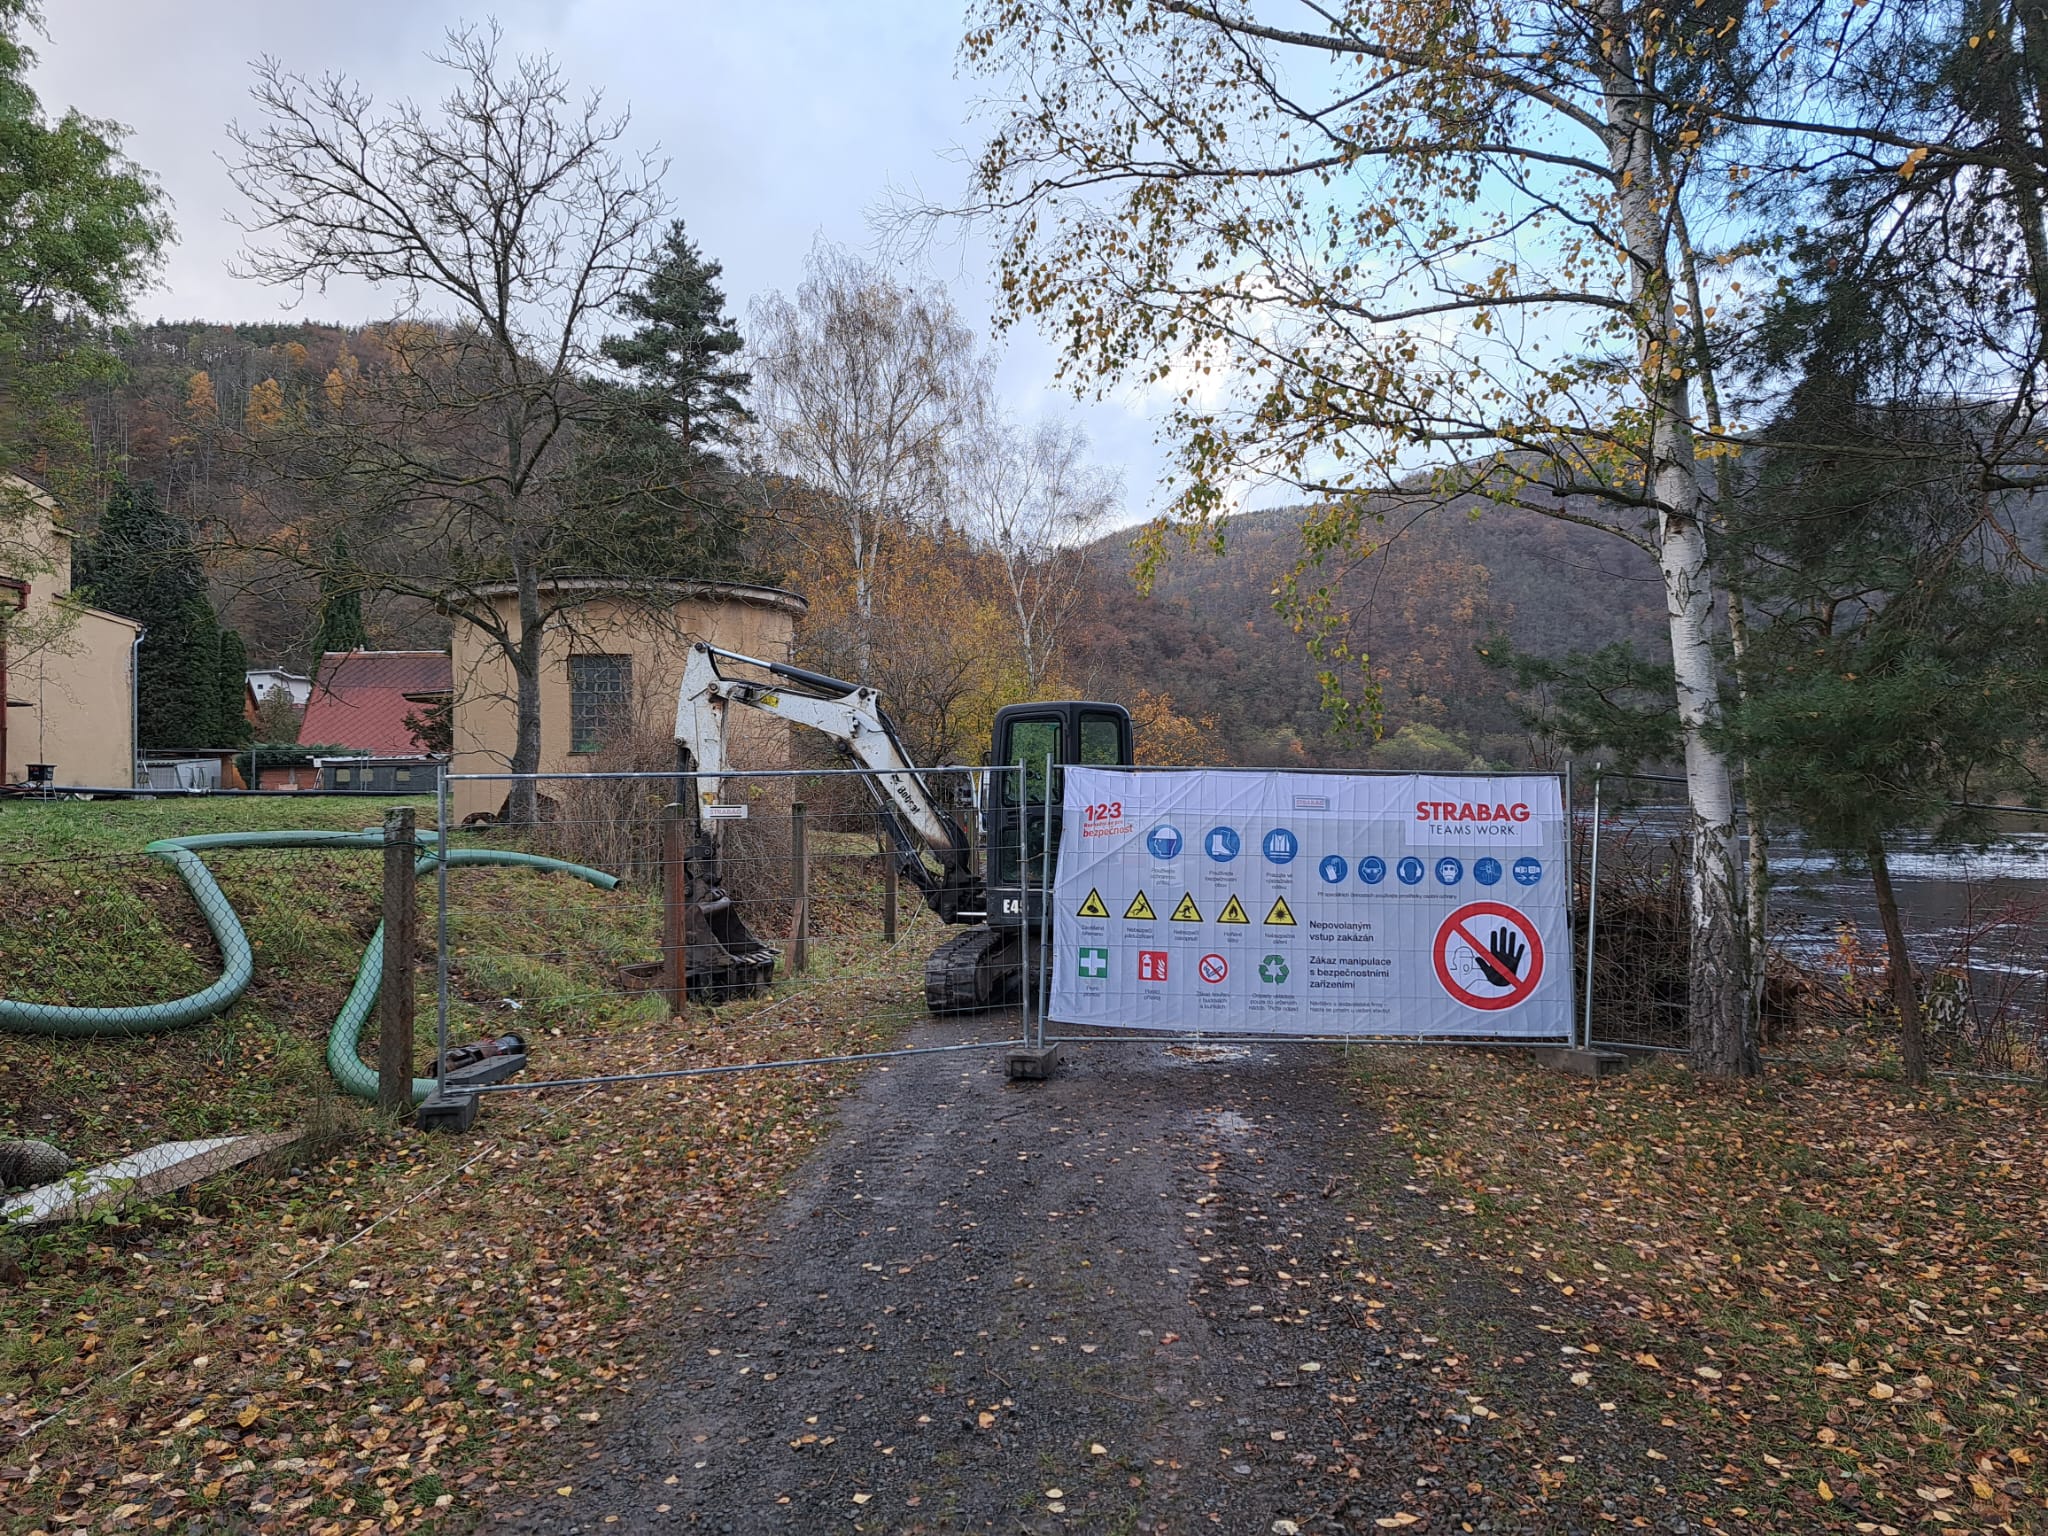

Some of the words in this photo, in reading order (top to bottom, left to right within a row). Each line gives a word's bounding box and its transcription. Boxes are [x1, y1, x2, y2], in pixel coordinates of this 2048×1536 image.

[1416, 801, 1530, 822] STRABAG
[1430, 824, 1472, 835] TEAMS
[1476, 825, 1518, 836] WORK.
[1309, 920, 1371, 932] Nepovolaným
[1309, 933, 1335, 943] vstup
[1337, 933, 1374, 942] zakázán
[1309, 955, 1337, 965] Zákaz
[1339, 957, 1392, 967] manipulace
[1317, 967, 1390, 978] bezpečnostními
[1309, 979, 1356, 989] zařízeními
